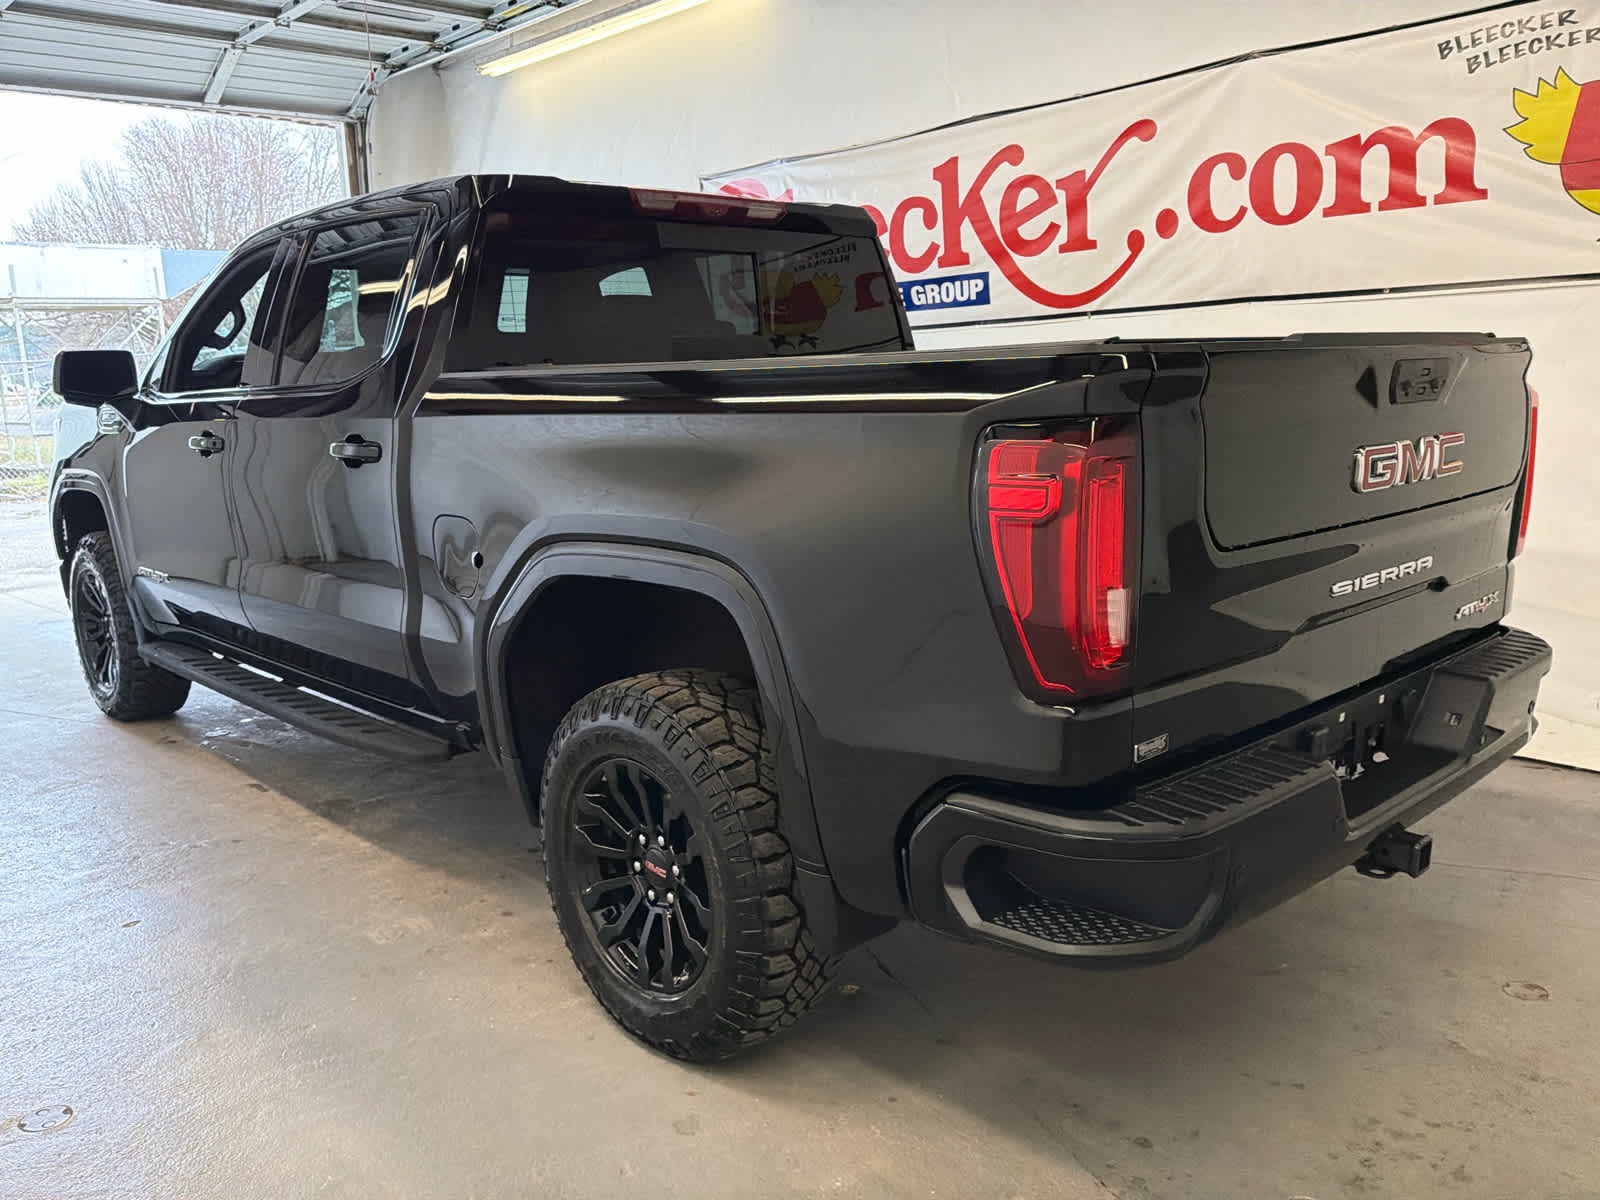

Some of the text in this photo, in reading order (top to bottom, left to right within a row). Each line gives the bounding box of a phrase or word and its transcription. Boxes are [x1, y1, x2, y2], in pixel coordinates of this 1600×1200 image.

[1437, 9, 1579, 60] BLEECKER
[912, 278, 986, 307] GROUP
[1353, 431, 1466, 492] GMC
[1330, 555, 1434, 598] SIERRA
